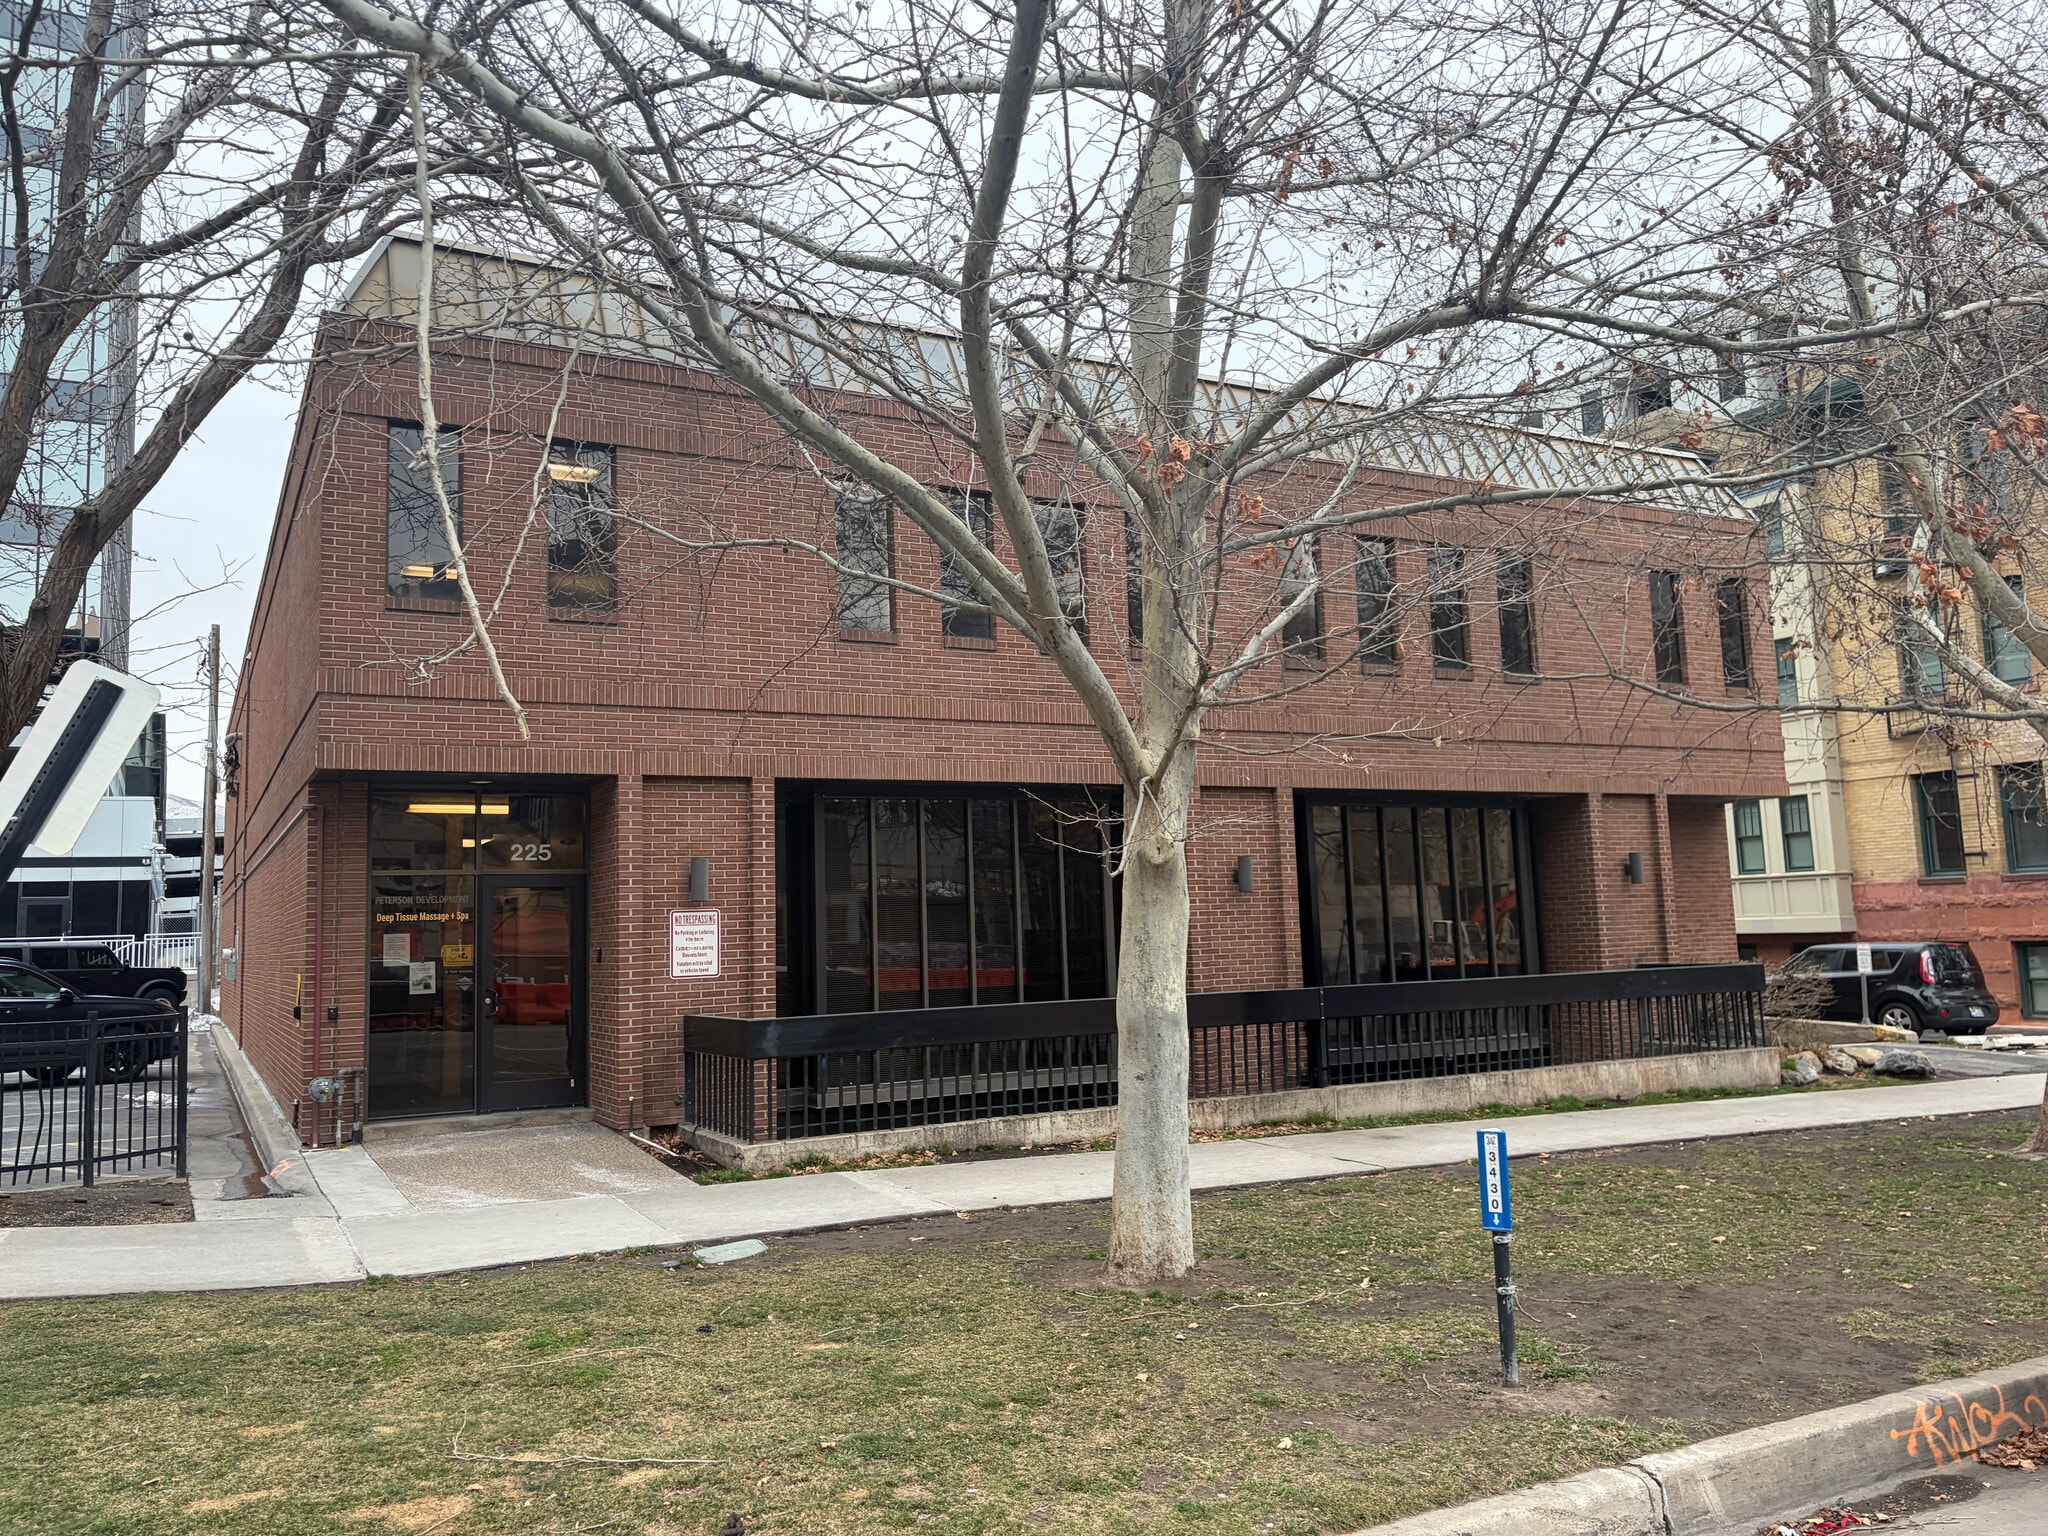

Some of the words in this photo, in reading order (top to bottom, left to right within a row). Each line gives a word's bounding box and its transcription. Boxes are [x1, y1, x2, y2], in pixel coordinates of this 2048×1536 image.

[510, 843, 552, 862] 225
[375, 895, 414, 905] PETERSON
[415, 894, 469, 904] DEVELOPMENT
[376, 912, 395, 924] Deep
[395, 912, 418, 922] Tissue
[419, 911, 450, 923] Massage
[456, 911, 469, 922] Spa
[674, 915, 682, 925] NO
[682, 914, 716, 925] TRESPASSING
[1488, 1151, 1499, 1210] 3430
